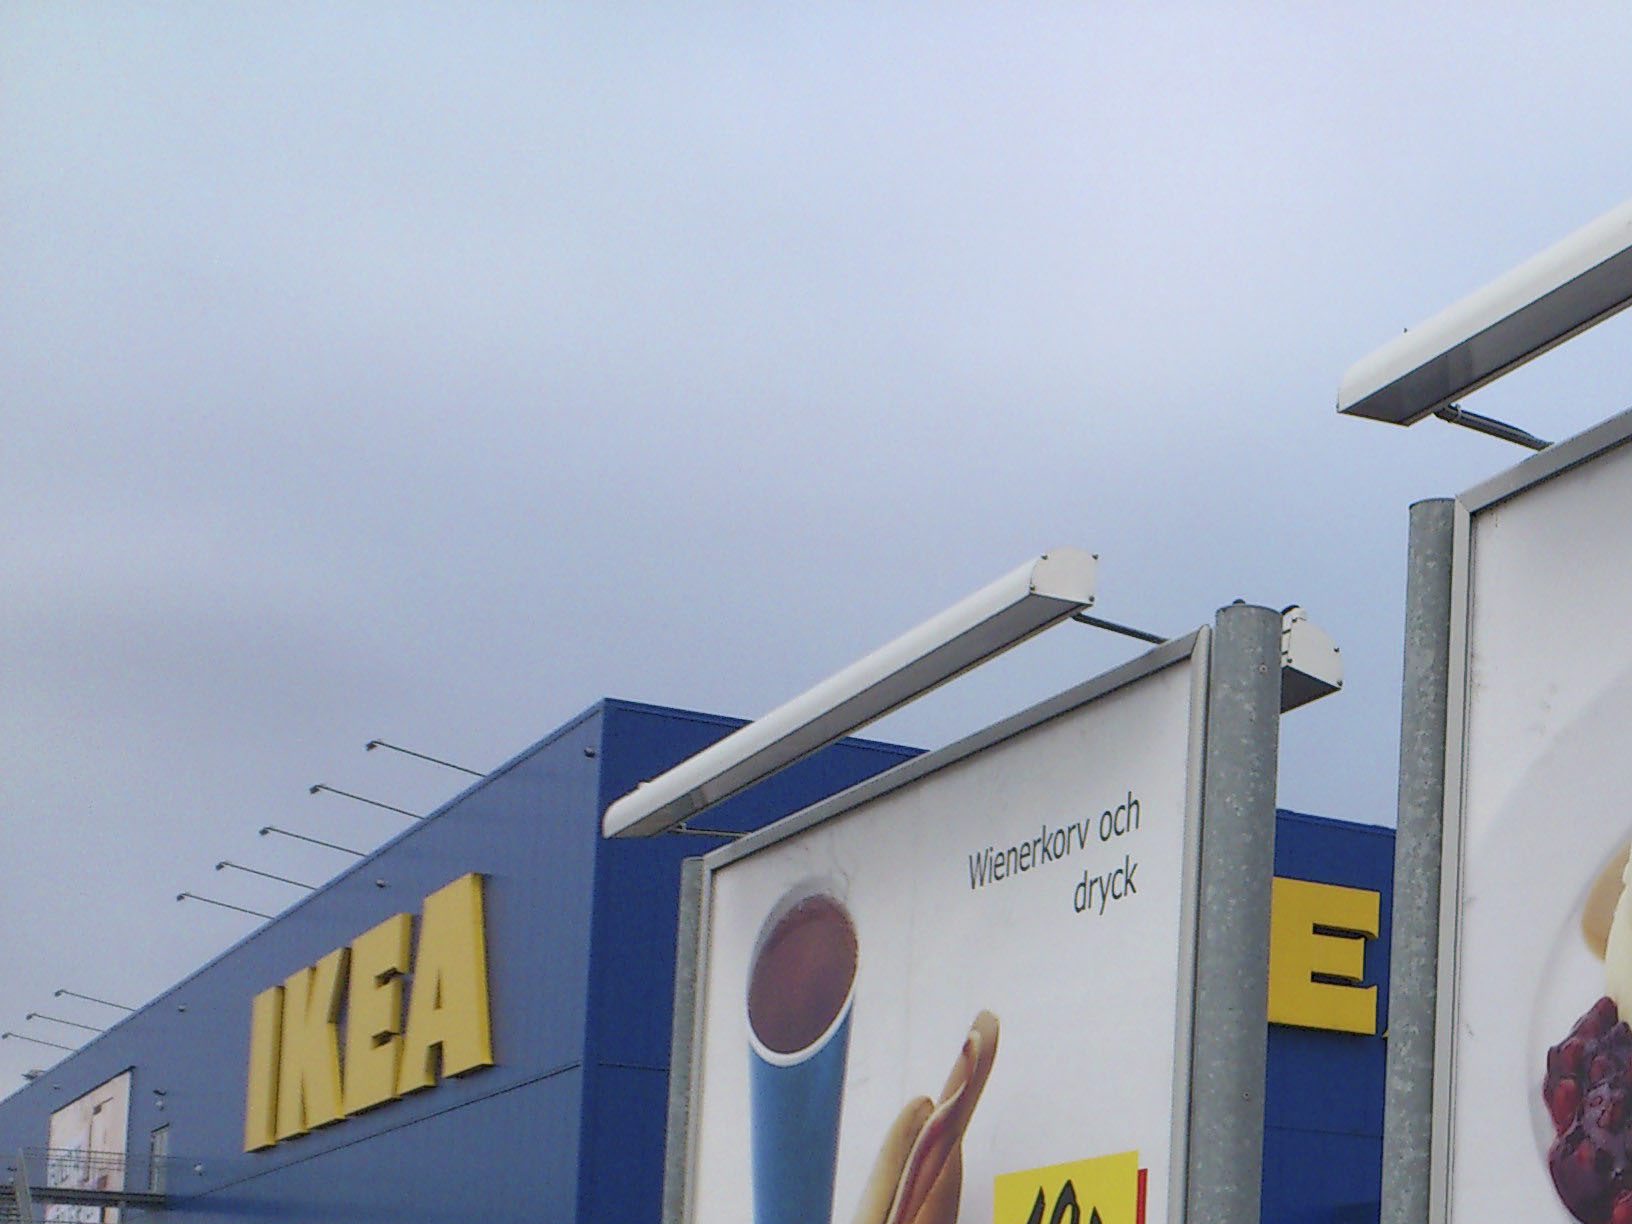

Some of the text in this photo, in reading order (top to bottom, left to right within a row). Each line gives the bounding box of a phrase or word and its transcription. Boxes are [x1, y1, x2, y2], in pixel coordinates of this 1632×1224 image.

[968, 791, 1141, 890] Wienerkorv och
[1073, 854, 1139, 916] dryck
[244, 873, 494, 1153] IKEA
[1267, 876, 1388, 1040] E
